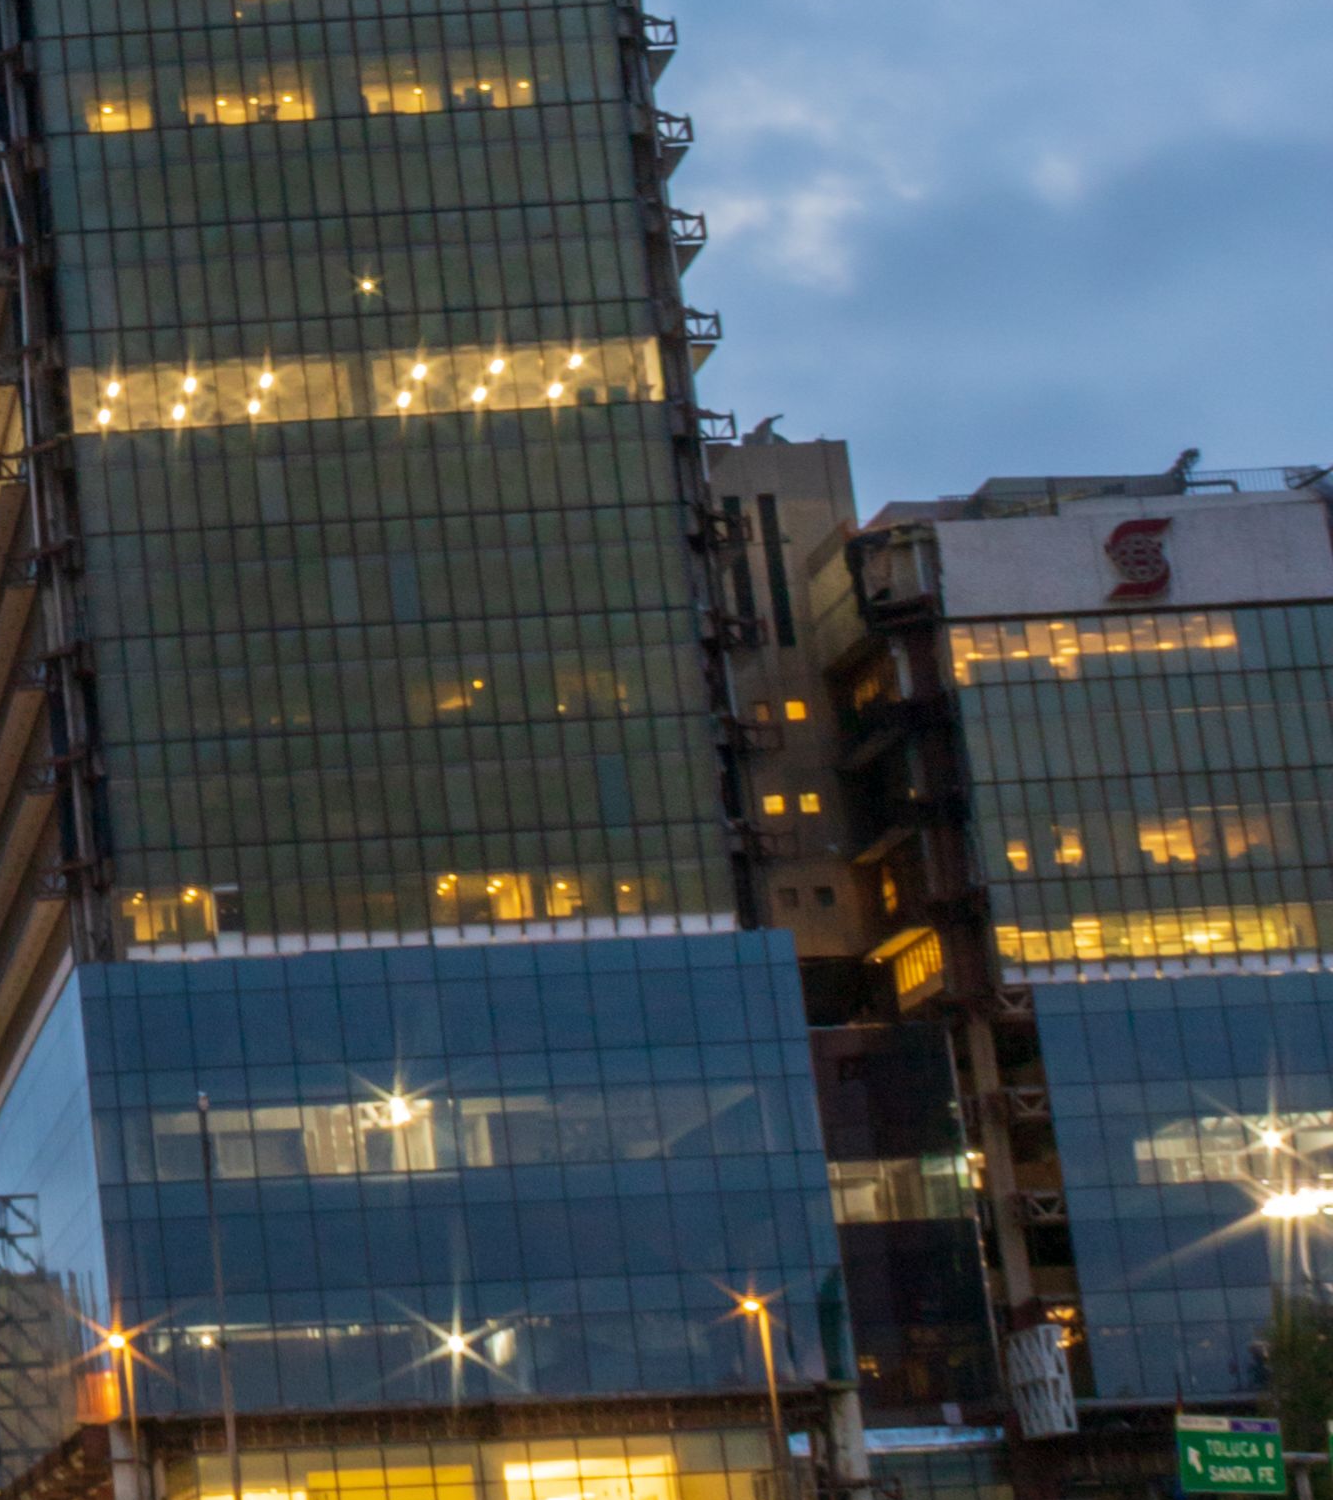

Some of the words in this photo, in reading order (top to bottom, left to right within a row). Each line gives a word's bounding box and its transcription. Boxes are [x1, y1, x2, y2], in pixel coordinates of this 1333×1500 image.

[1206, 1439, 1259, 1458] TOLUCA
[1208, 1465, 1253, 1483] SANTA
[1258, 1466, 1276, 1485] FE
